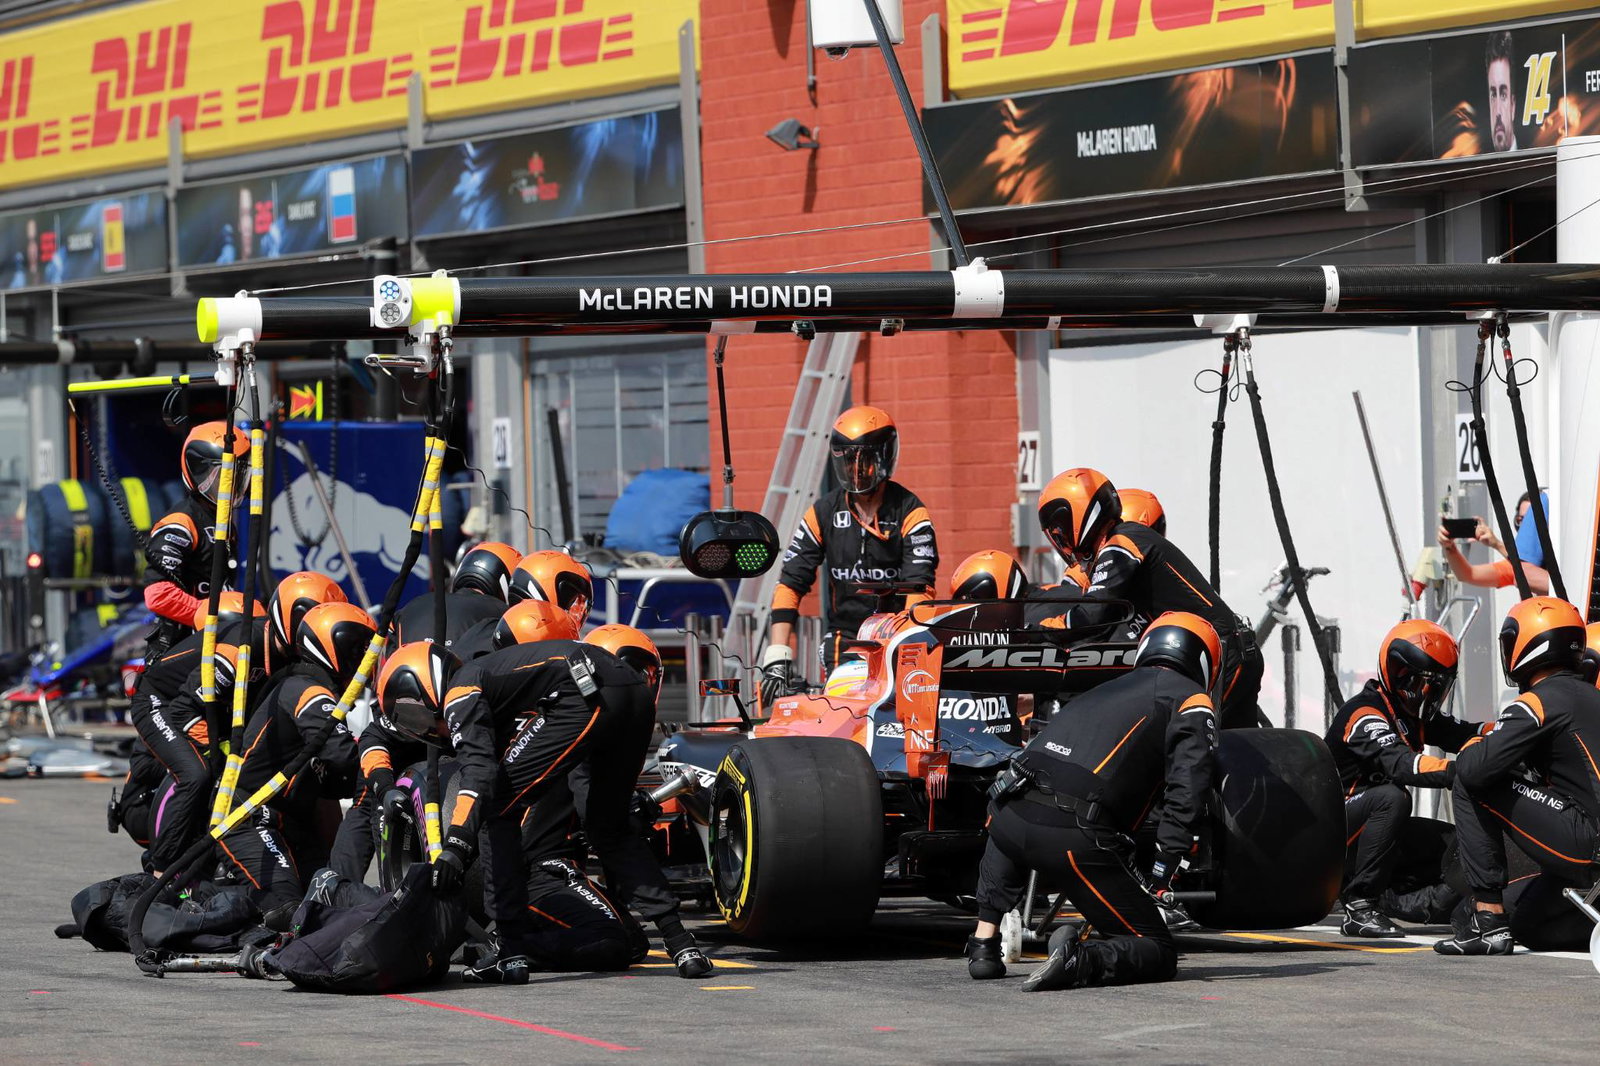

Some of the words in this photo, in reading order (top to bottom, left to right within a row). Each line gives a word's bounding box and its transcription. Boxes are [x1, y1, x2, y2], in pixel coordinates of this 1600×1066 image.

[91, 22, 200, 148] DHL
[1521, 51, 1558, 126] 14
[1077, 126, 1121, 158] McLAREN
[1123, 123, 1157, 152] HONDA
[578, 286, 714, 311] McLAREN
[730, 285, 833, 309] HONDA
[1019, 439, 1037, 484] 27
[1459, 421, 1481, 473] 26
[831, 567, 903, 581] CHANDO
[943, 648, 1140, 669] McLar
[938, 695, 1012, 721] HONDA
[982, 723, 1012, 735] HYBRID
[506, 728, 535, 764] HONDA
[1511, 780, 1548, 803] HONDA
